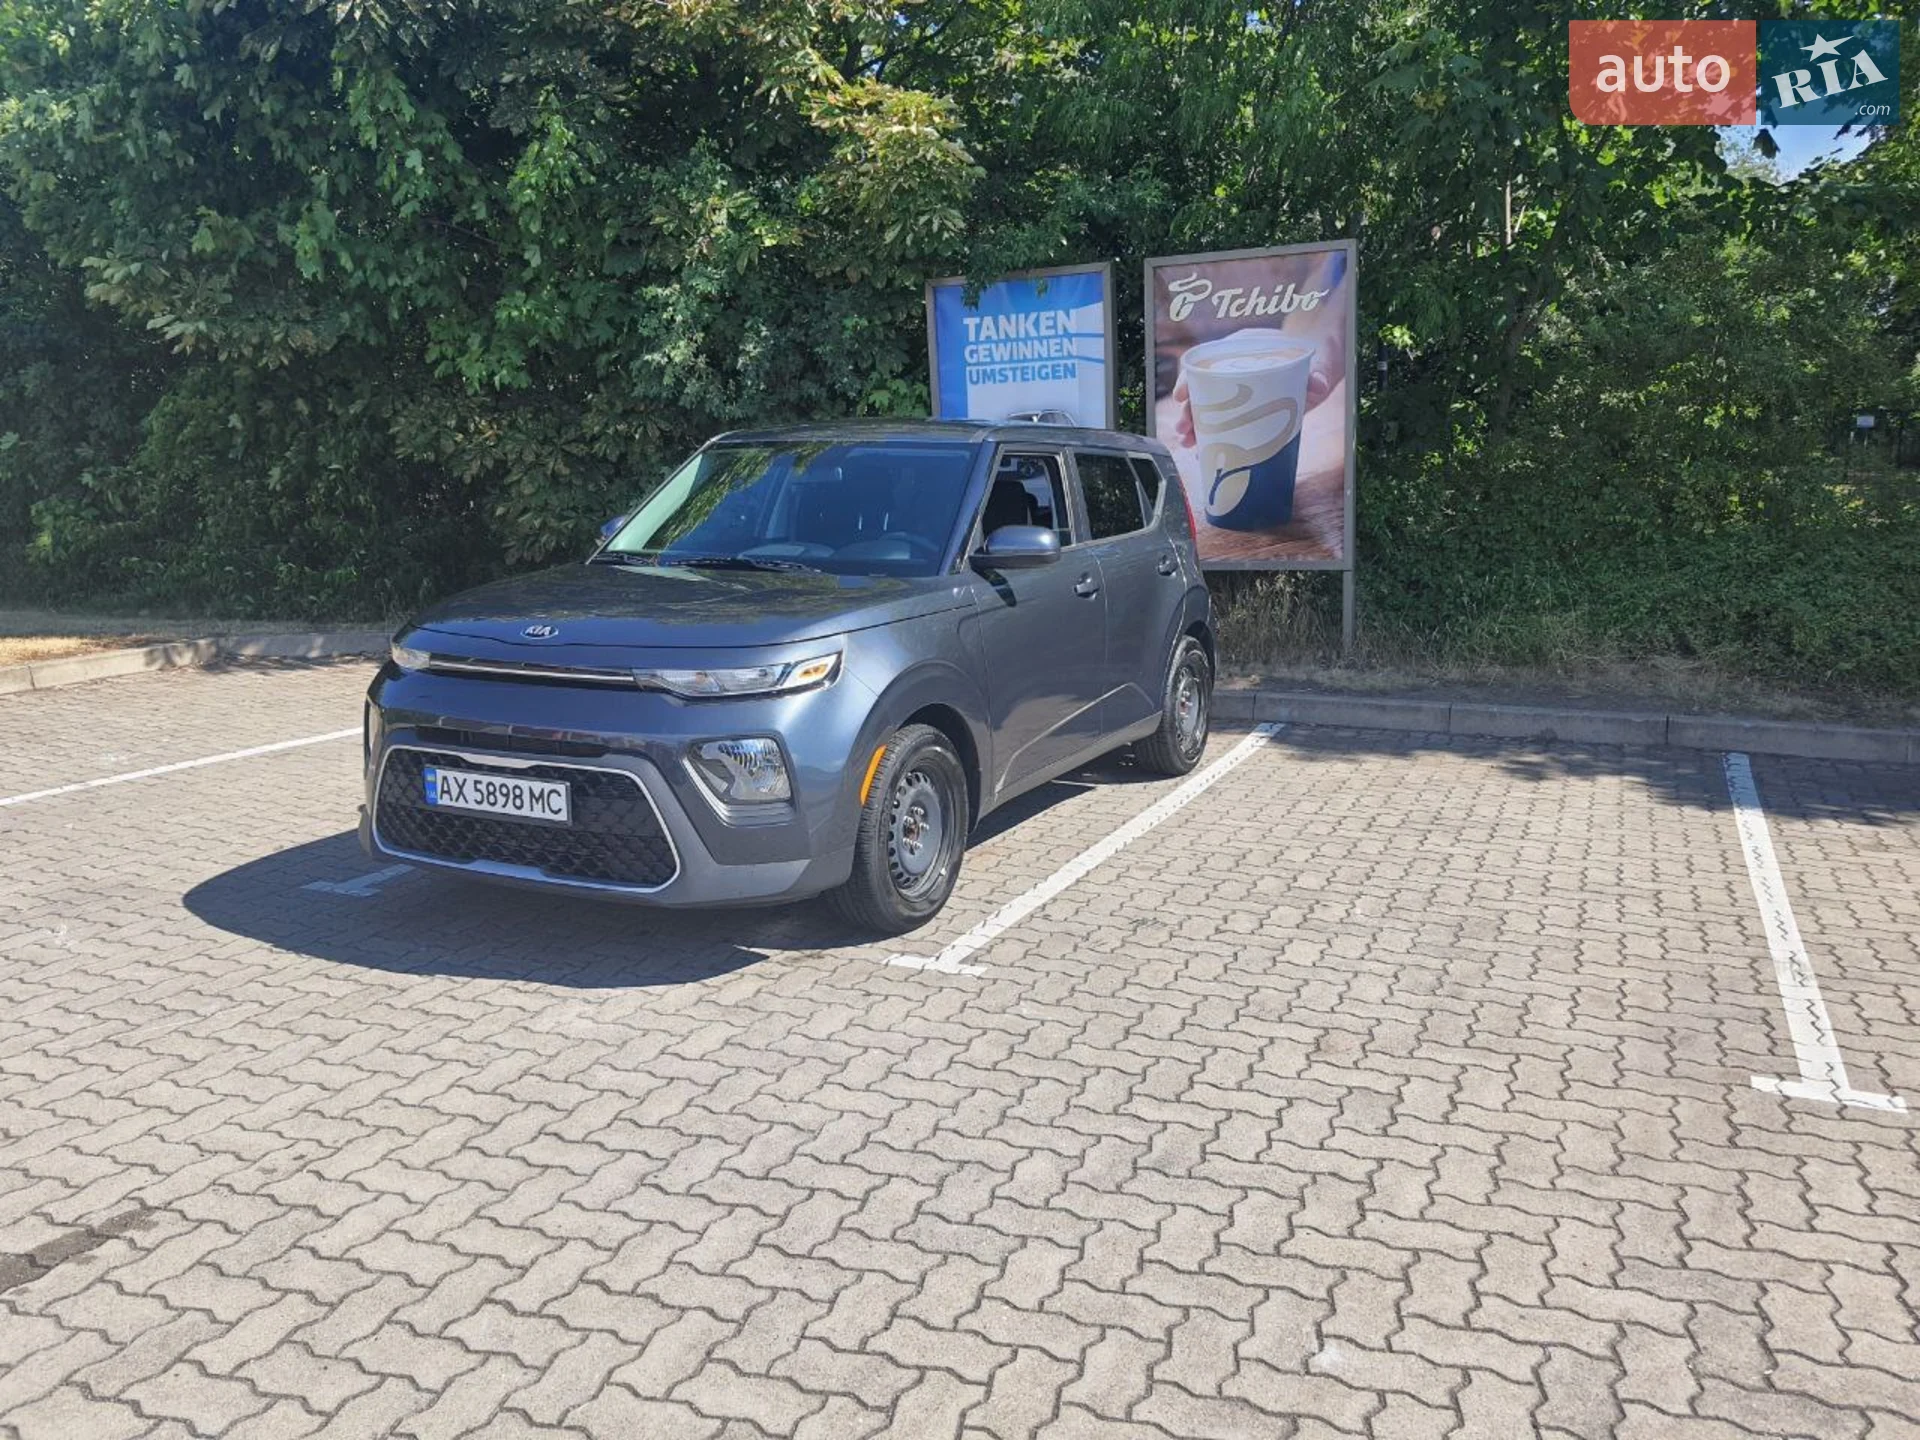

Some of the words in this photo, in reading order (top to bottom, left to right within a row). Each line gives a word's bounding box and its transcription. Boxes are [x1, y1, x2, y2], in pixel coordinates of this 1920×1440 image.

[1212, 283, 1329, 318] Tchibo
[963, 308, 1078, 342] TANKEN
[964, 337, 1077, 364] GEWINNEN
[968, 362, 1077, 385] UMSTEIGEN
[525, 625, 551, 636] KIA
[439, 775, 469, 804] AX
[473, 779, 524, 811] 5898
[529, 786, 562, 815] MC
